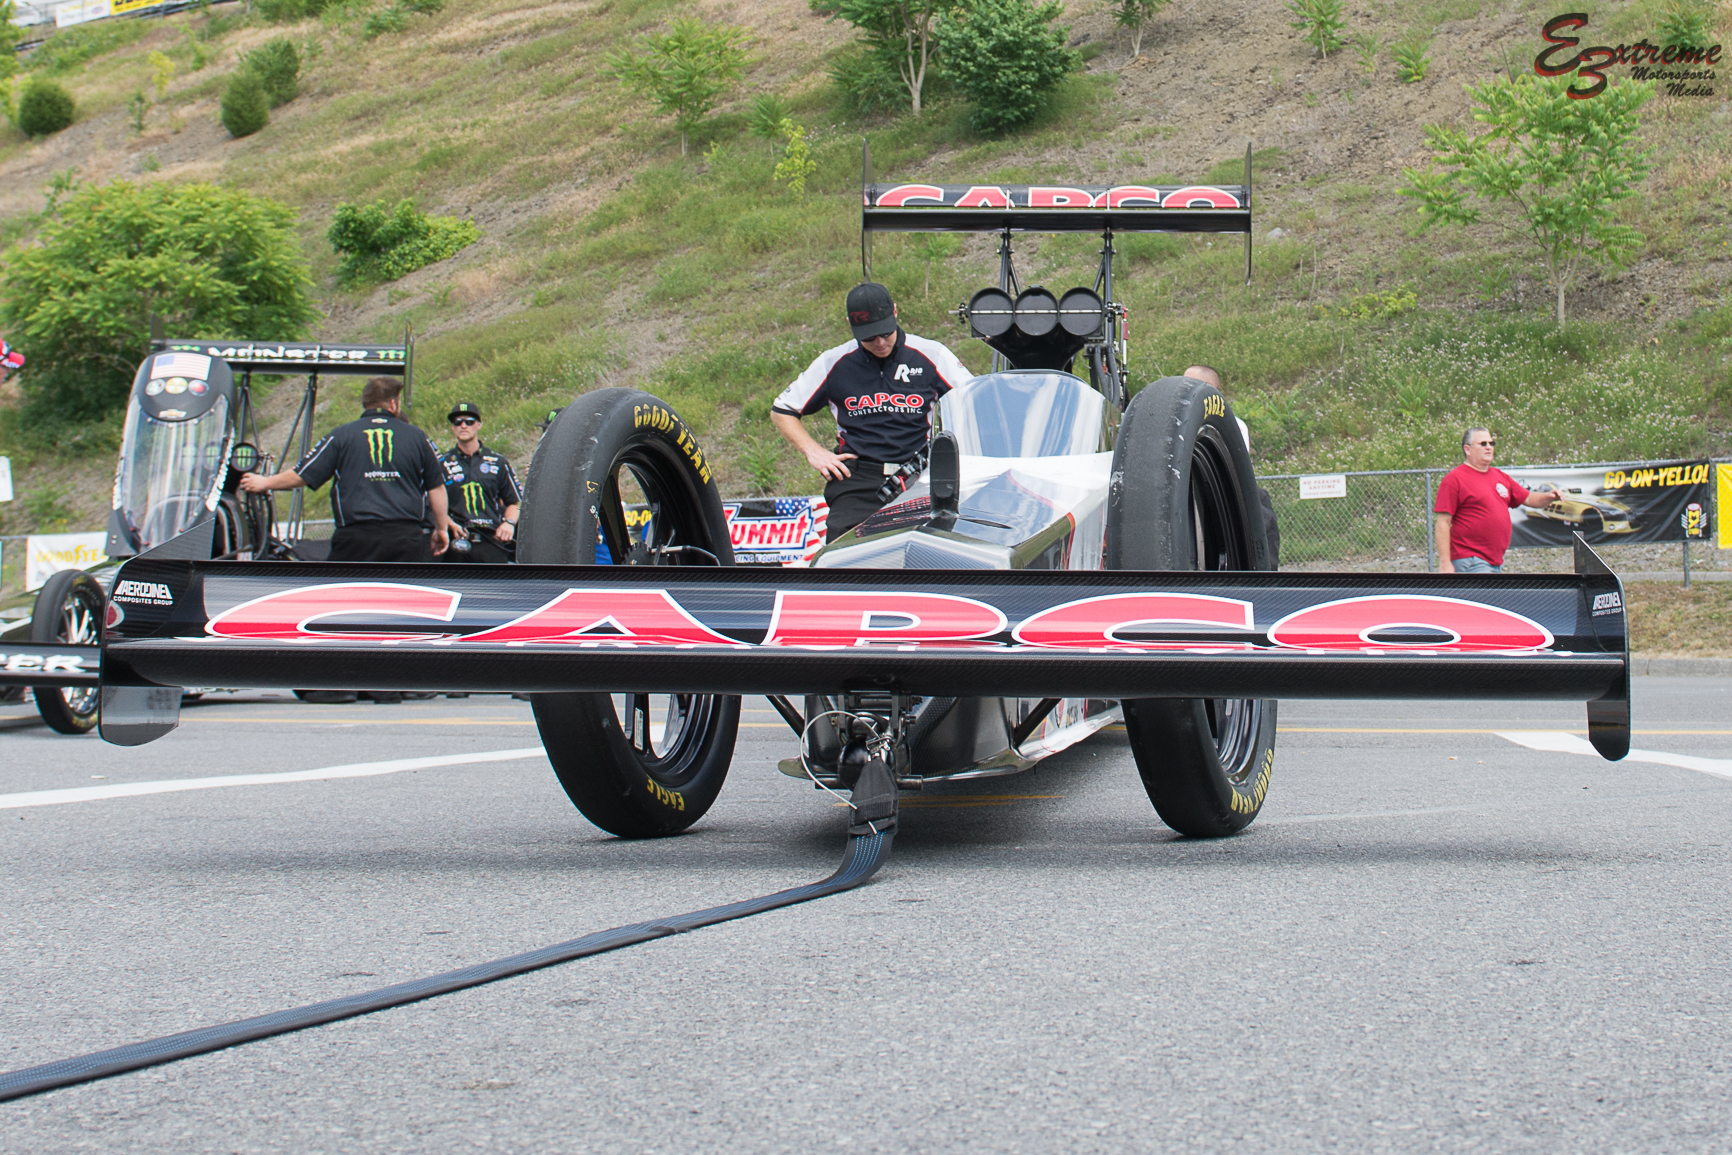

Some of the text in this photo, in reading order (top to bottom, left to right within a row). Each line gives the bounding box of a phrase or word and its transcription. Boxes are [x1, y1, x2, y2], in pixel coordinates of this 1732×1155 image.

[875, 184, 1241, 208] CAPCO
[844, 392, 924, 411] CAPCO
[848, 405, 922, 417] CONTRACTORS INC.
[1203, 394, 1225, 419] EAGLE
[634, 403, 712, 485] GOODYEAR
[364, 470, 400, 478] MONSTER
[1604, 463, 1710, 490] GO-ON-YELLO!
[755, 553, 803, 563] EQUIPMENT
[113, 595, 152, 604] COMPOSITES
[204, 582, 1556, 650] CAPCO
[646, 778, 685, 811] EAGLE
